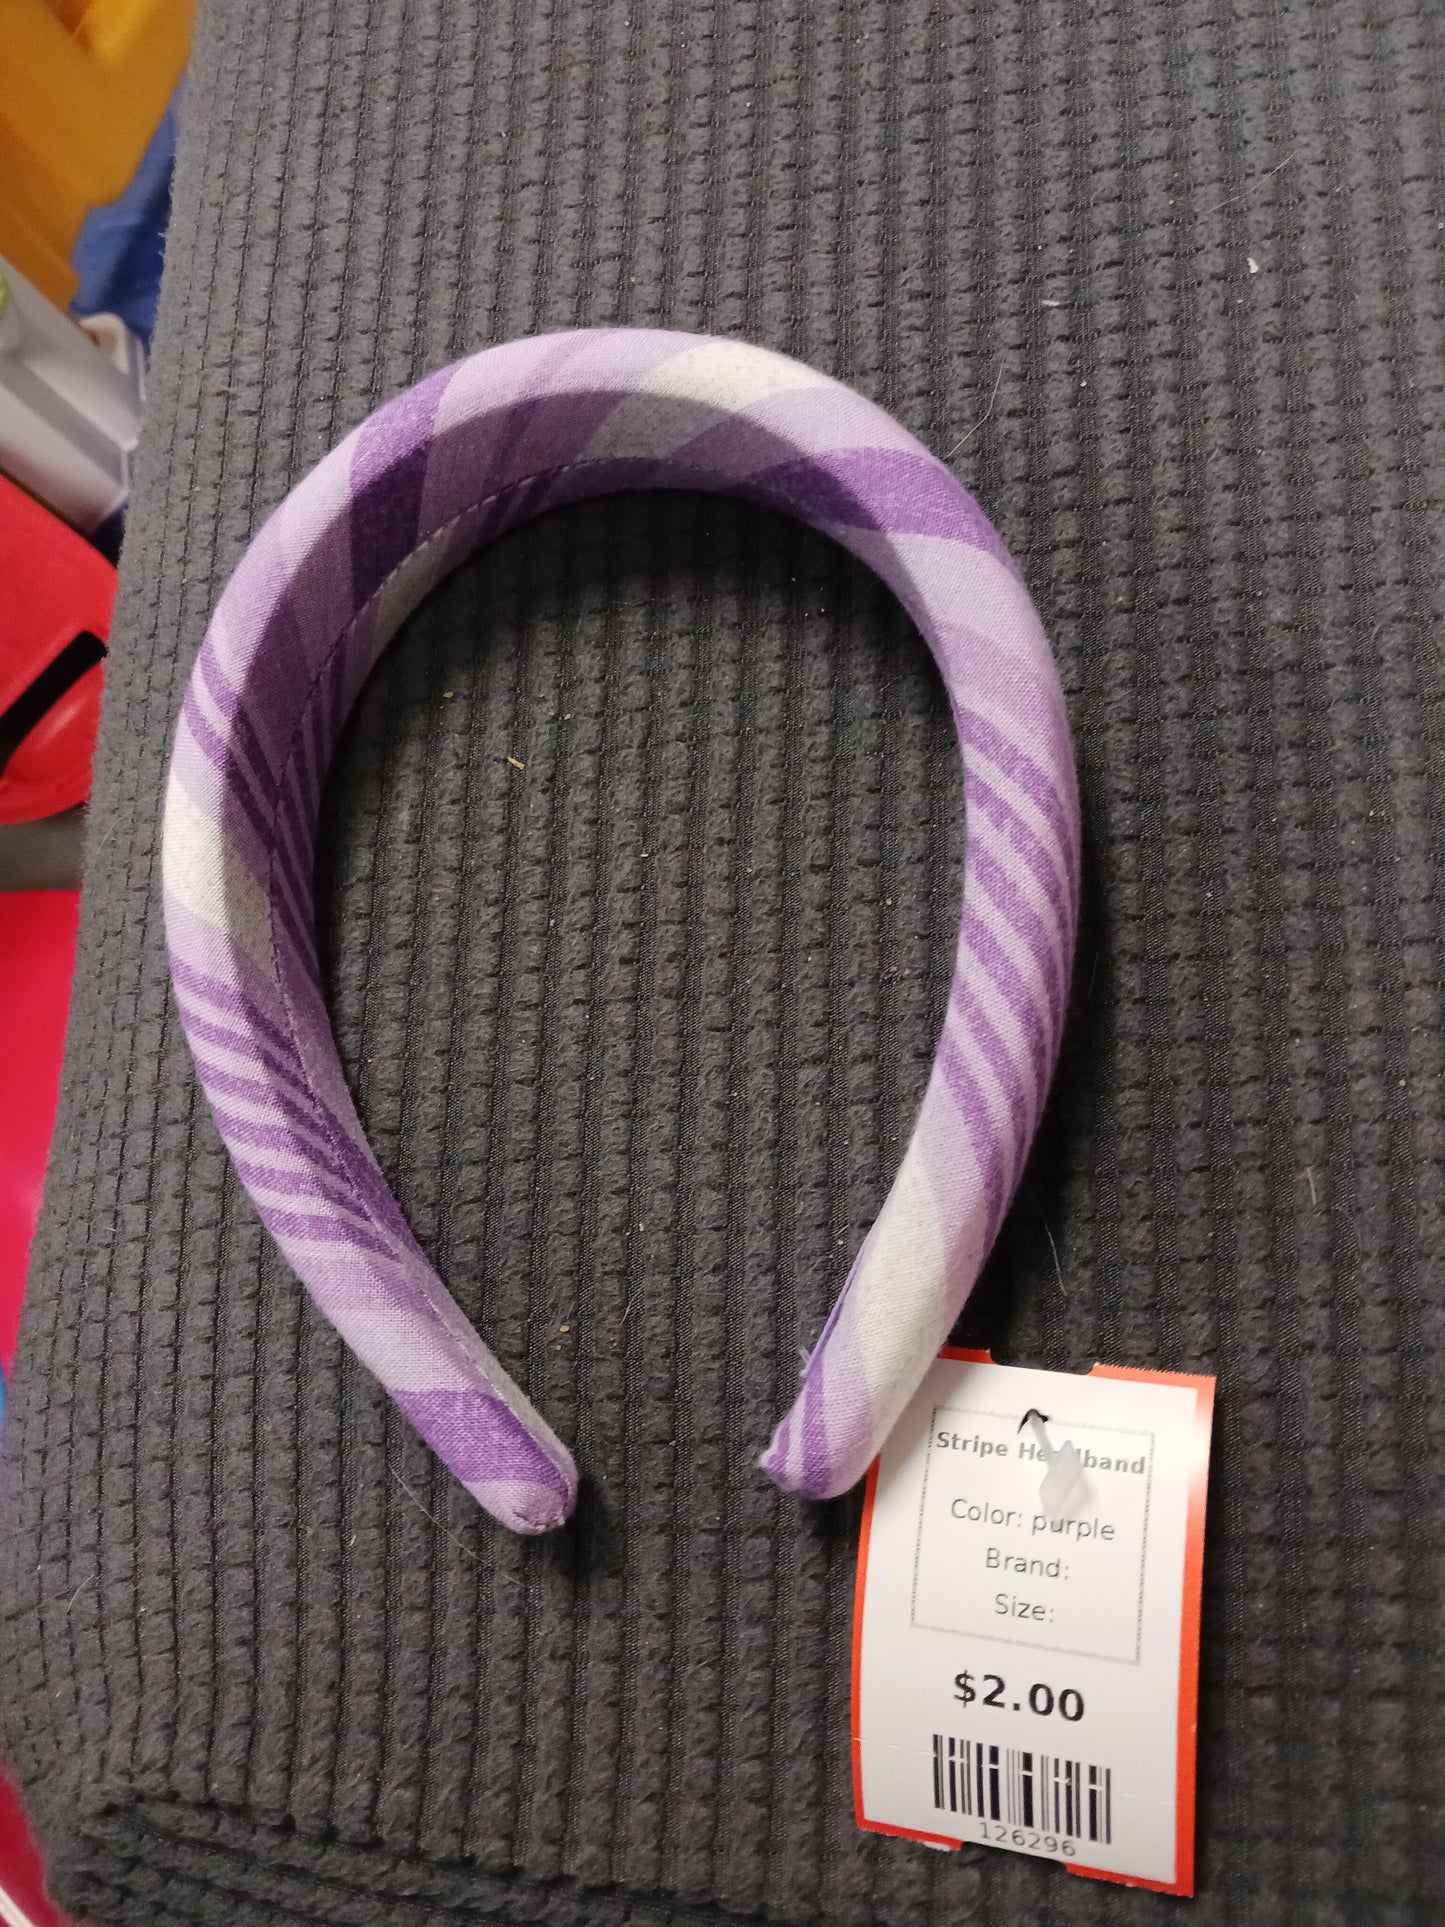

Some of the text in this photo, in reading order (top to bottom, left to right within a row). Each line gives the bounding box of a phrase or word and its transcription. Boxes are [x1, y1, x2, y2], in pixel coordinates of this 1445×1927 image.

[936, 1431, 1146, 1475] Stripe Heband
[951, 1498, 1116, 1541] Color: purple
[985, 1547, 1070, 1580] Brand:
[994, 1593, 1055, 1623] Size:
[953, 1669, 1085, 1722] $2.00
[980, 1821, 1076, 1857] 126296
